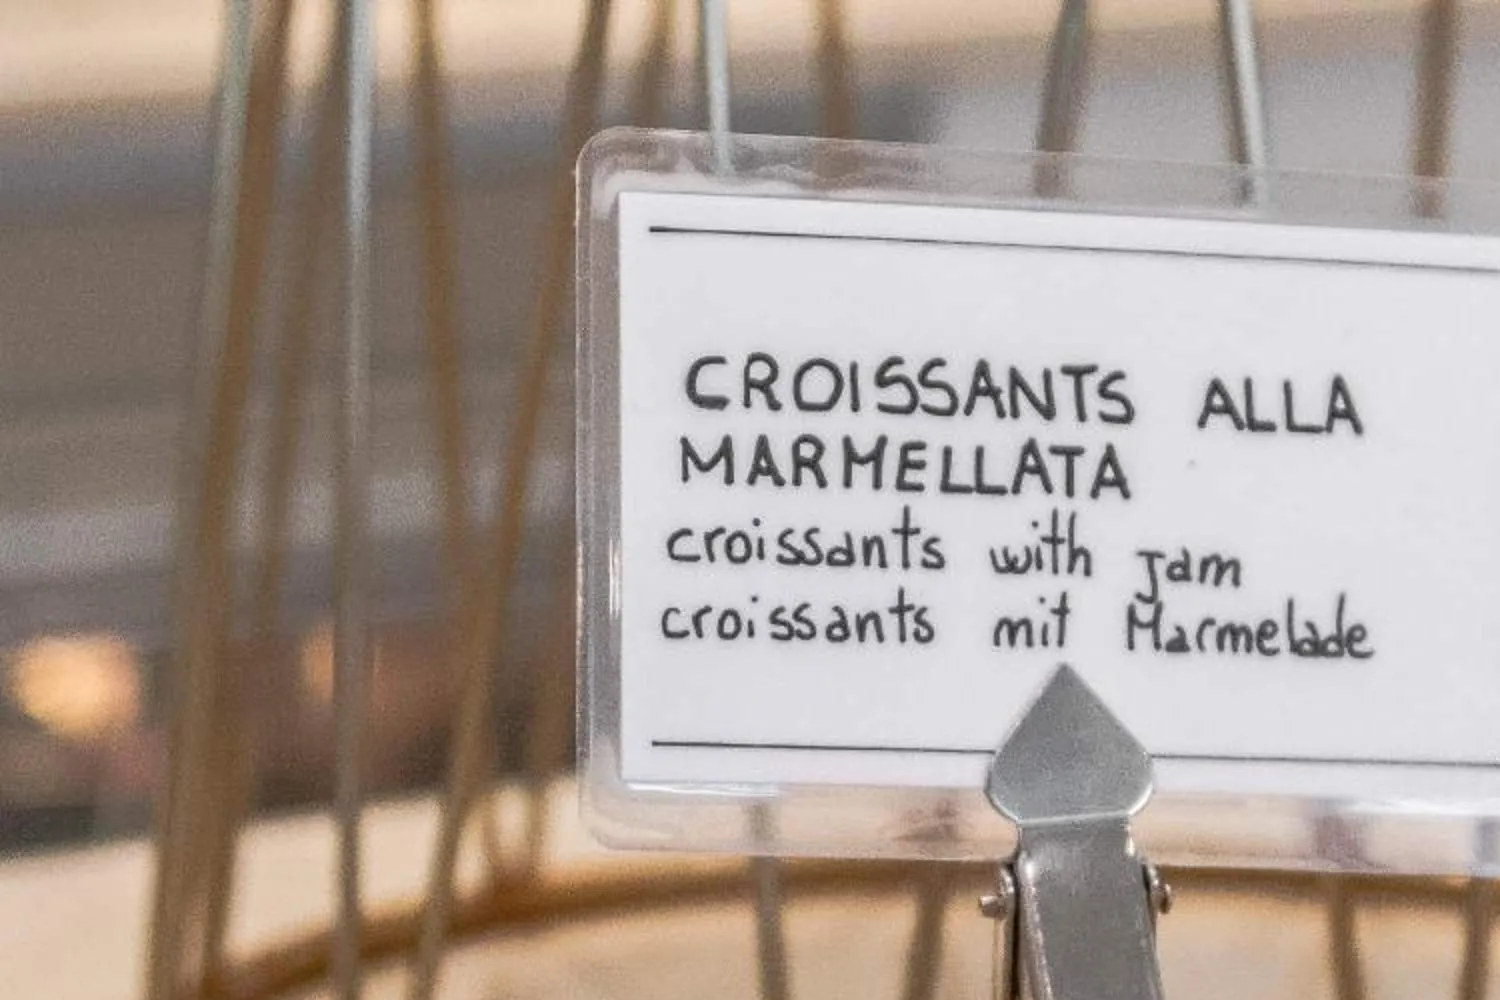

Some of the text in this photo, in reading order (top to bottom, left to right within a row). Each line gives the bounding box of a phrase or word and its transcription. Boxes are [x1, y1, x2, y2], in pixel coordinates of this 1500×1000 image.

[685, 352, 1363, 435] CROISSANTS ALLA
[680, 434, 1131, 500] MARMELLATA
[667, 506, 945, 570] croissants
[990, 509, 1091, 577] with
[662, 588, 1373, 659] croissants mit Marmelade
